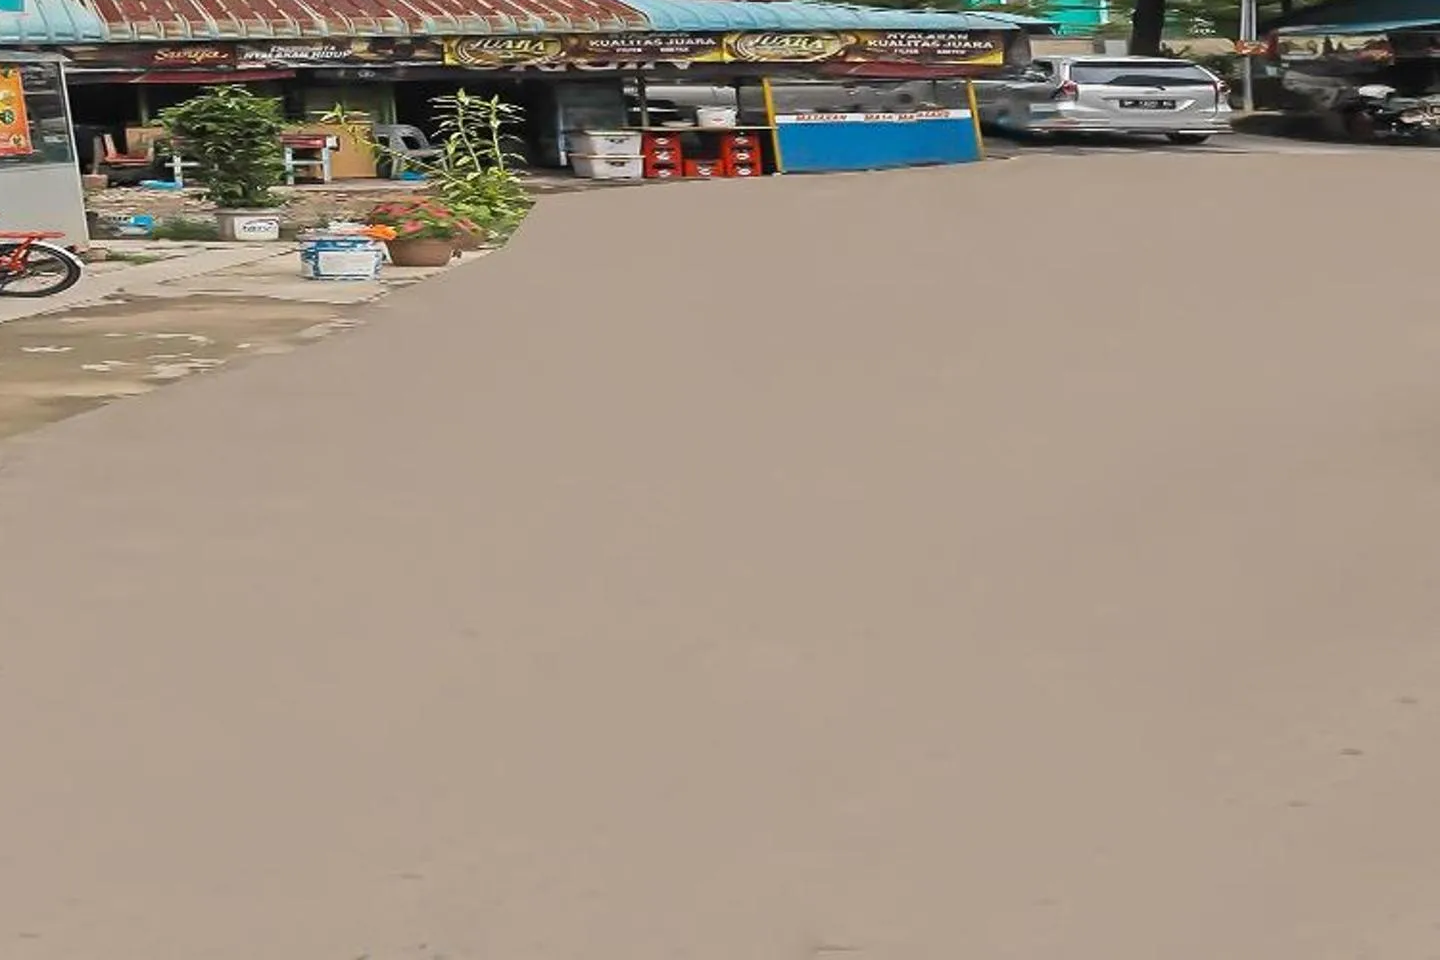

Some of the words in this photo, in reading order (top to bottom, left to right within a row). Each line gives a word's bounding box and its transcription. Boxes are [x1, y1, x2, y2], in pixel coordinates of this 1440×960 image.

[589, 38, 663, 48] KUALITAS
[867, 39, 940, 48] KUALITAS
[943, 40, 994, 49] JUARA
